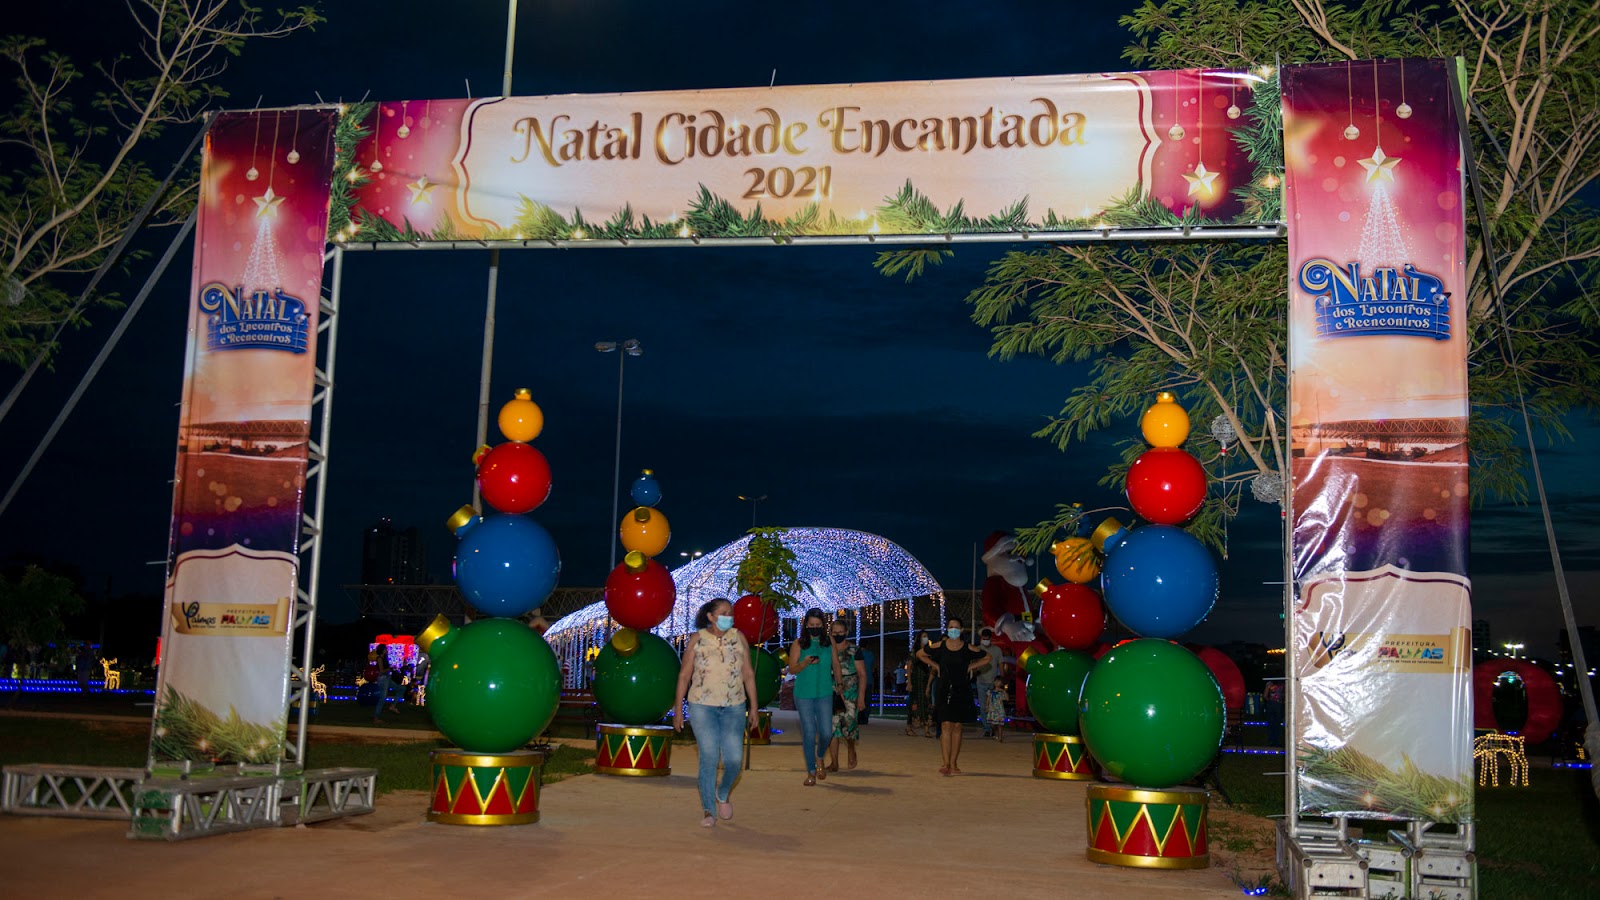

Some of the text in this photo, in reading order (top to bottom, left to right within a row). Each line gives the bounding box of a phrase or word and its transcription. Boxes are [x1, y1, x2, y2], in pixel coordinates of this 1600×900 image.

[511, 97, 1087, 167] Natal Cidade Encantada
[742, 166, 833, 200] 2021
[1301, 258, 1427, 305] NATAL
[201, 282, 291, 323] NATAL
[1332, 303, 1431, 319] dos Encontros
[219, 322, 293, 335] dos Encontros
[1335, 316, 1430, 330] e Reencontros
[220, 333, 292, 345] e Reencontros
